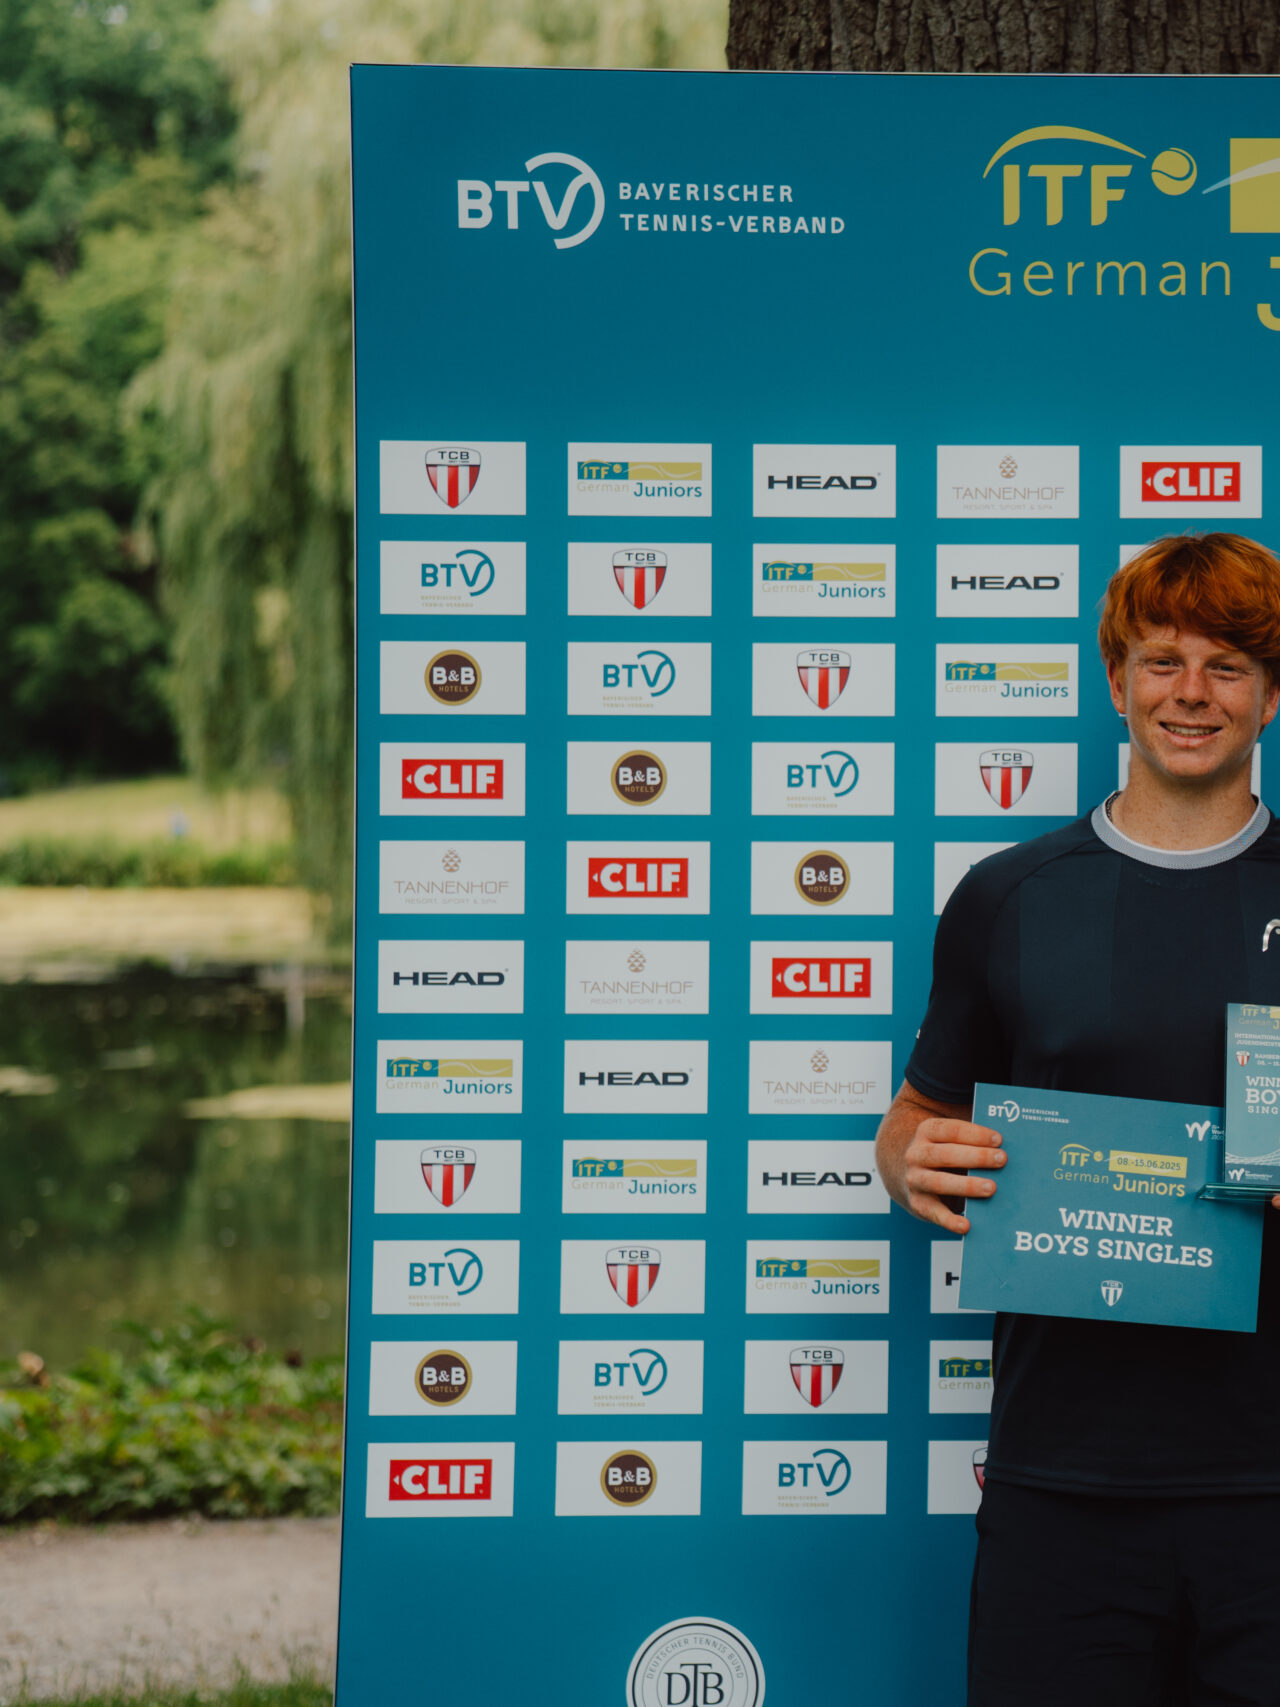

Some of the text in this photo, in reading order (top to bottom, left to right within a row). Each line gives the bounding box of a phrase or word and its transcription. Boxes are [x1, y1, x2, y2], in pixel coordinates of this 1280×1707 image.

[457, 165, 590, 236] BTV
[619, 183, 795, 203] BAYERISCHER
[1003, 164, 1134, 227] ITF
[620, 214, 846, 235] TENNIS-VERBAND
[969, 248, 1231, 297] German
[438, 451, 469, 460] TCB
[583, 466, 609, 479] ITF
[767, 476, 877, 489] HEAD
[1153, 467, 1232, 496] CLIF
[576, 482, 703, 498] German Juniors
[952, 487, 1064, 500] TANNENHOF
[625, 552, 655, 561] TCB
[421, 557, 488, 588] BTV
[768, 567, 794, 580] ITF
[761, 583, 886, 598] German Juniors
[951, 576, 1060, 589] HEAD
[809, 653, 839, 662] TCB
[432, 666, 475, 685] B&B
[603, 658, 669, 688] BTV
[951, 667, 977, 680] ITF
[944, 683, 1069, 698] German Juniors
[991, 753, 1022, 761] TCB
[413, 764, 495, 793] CLIF
[618, 766, 661, 785] B&B
[787, 758, 852, 789] BTV
[599, 863, 680, 892] CLIF
[802, 867, 844, 885] B&B
[393, 881, 509, 894] TANNENHOF
[393, 972, 505, 985] HEAD
[783, 963, 862, 992] CLIF
[579, 981, 693, 994] TANNENHOF
[1242, 1008, 1259, 1017] ITF
[392, 1063, 419, 1076] ITF
[579, 1072, 689, 1085] HEAD
[385, 1079, 513, 1095] German Juniors
[762, 1081, 877, 1094] TANNENHOF
[988, 1103, 1017, 1120] BTV
[1022, 1108, 1059, 1116] BAYERISCHER
[1022, 1115, 1069, 1124] TENNIS-VERBAND
[433, 1150, 464, 1158] TCB
[1061, 1151, 1089, 1167] ITF
[578, 1163, 604, 1176] ITF
[762, 1172, 872, 1185] HEAD
[1053, 1168, 1186, 1197] German Juniors
[571, 1179, 697, 1195] German Juniors
[1059, 1208, 1173, 1237] WINNER
[618, 1250, 649, 1259] TCB
[1014, 1231, 1213, 1268] BOYS SINGLES
[409, 1256, 476, 1287] BTV
[762, 1263, 788, 1276] ITF
[755, 1279, 880, 1295] German Juniors
[802, 1350, 832, 1359] TCB
[422, 1366, 466, 1385] B&B
[594, 1356, 661, 1387] BTV
[945, 1364, 971, 1377] ITF
[938, 1379, 991, 1390] German
[401, 1464, 483, 1494] CLIF
[607, 1466, 651, 1486] B&B
[778, 1457, 844, 1487] BTV
[647, 1637, 744, 1680] DEUTSCHER TENNIS BUND
[664, 1663, 725, 1707] DTB
